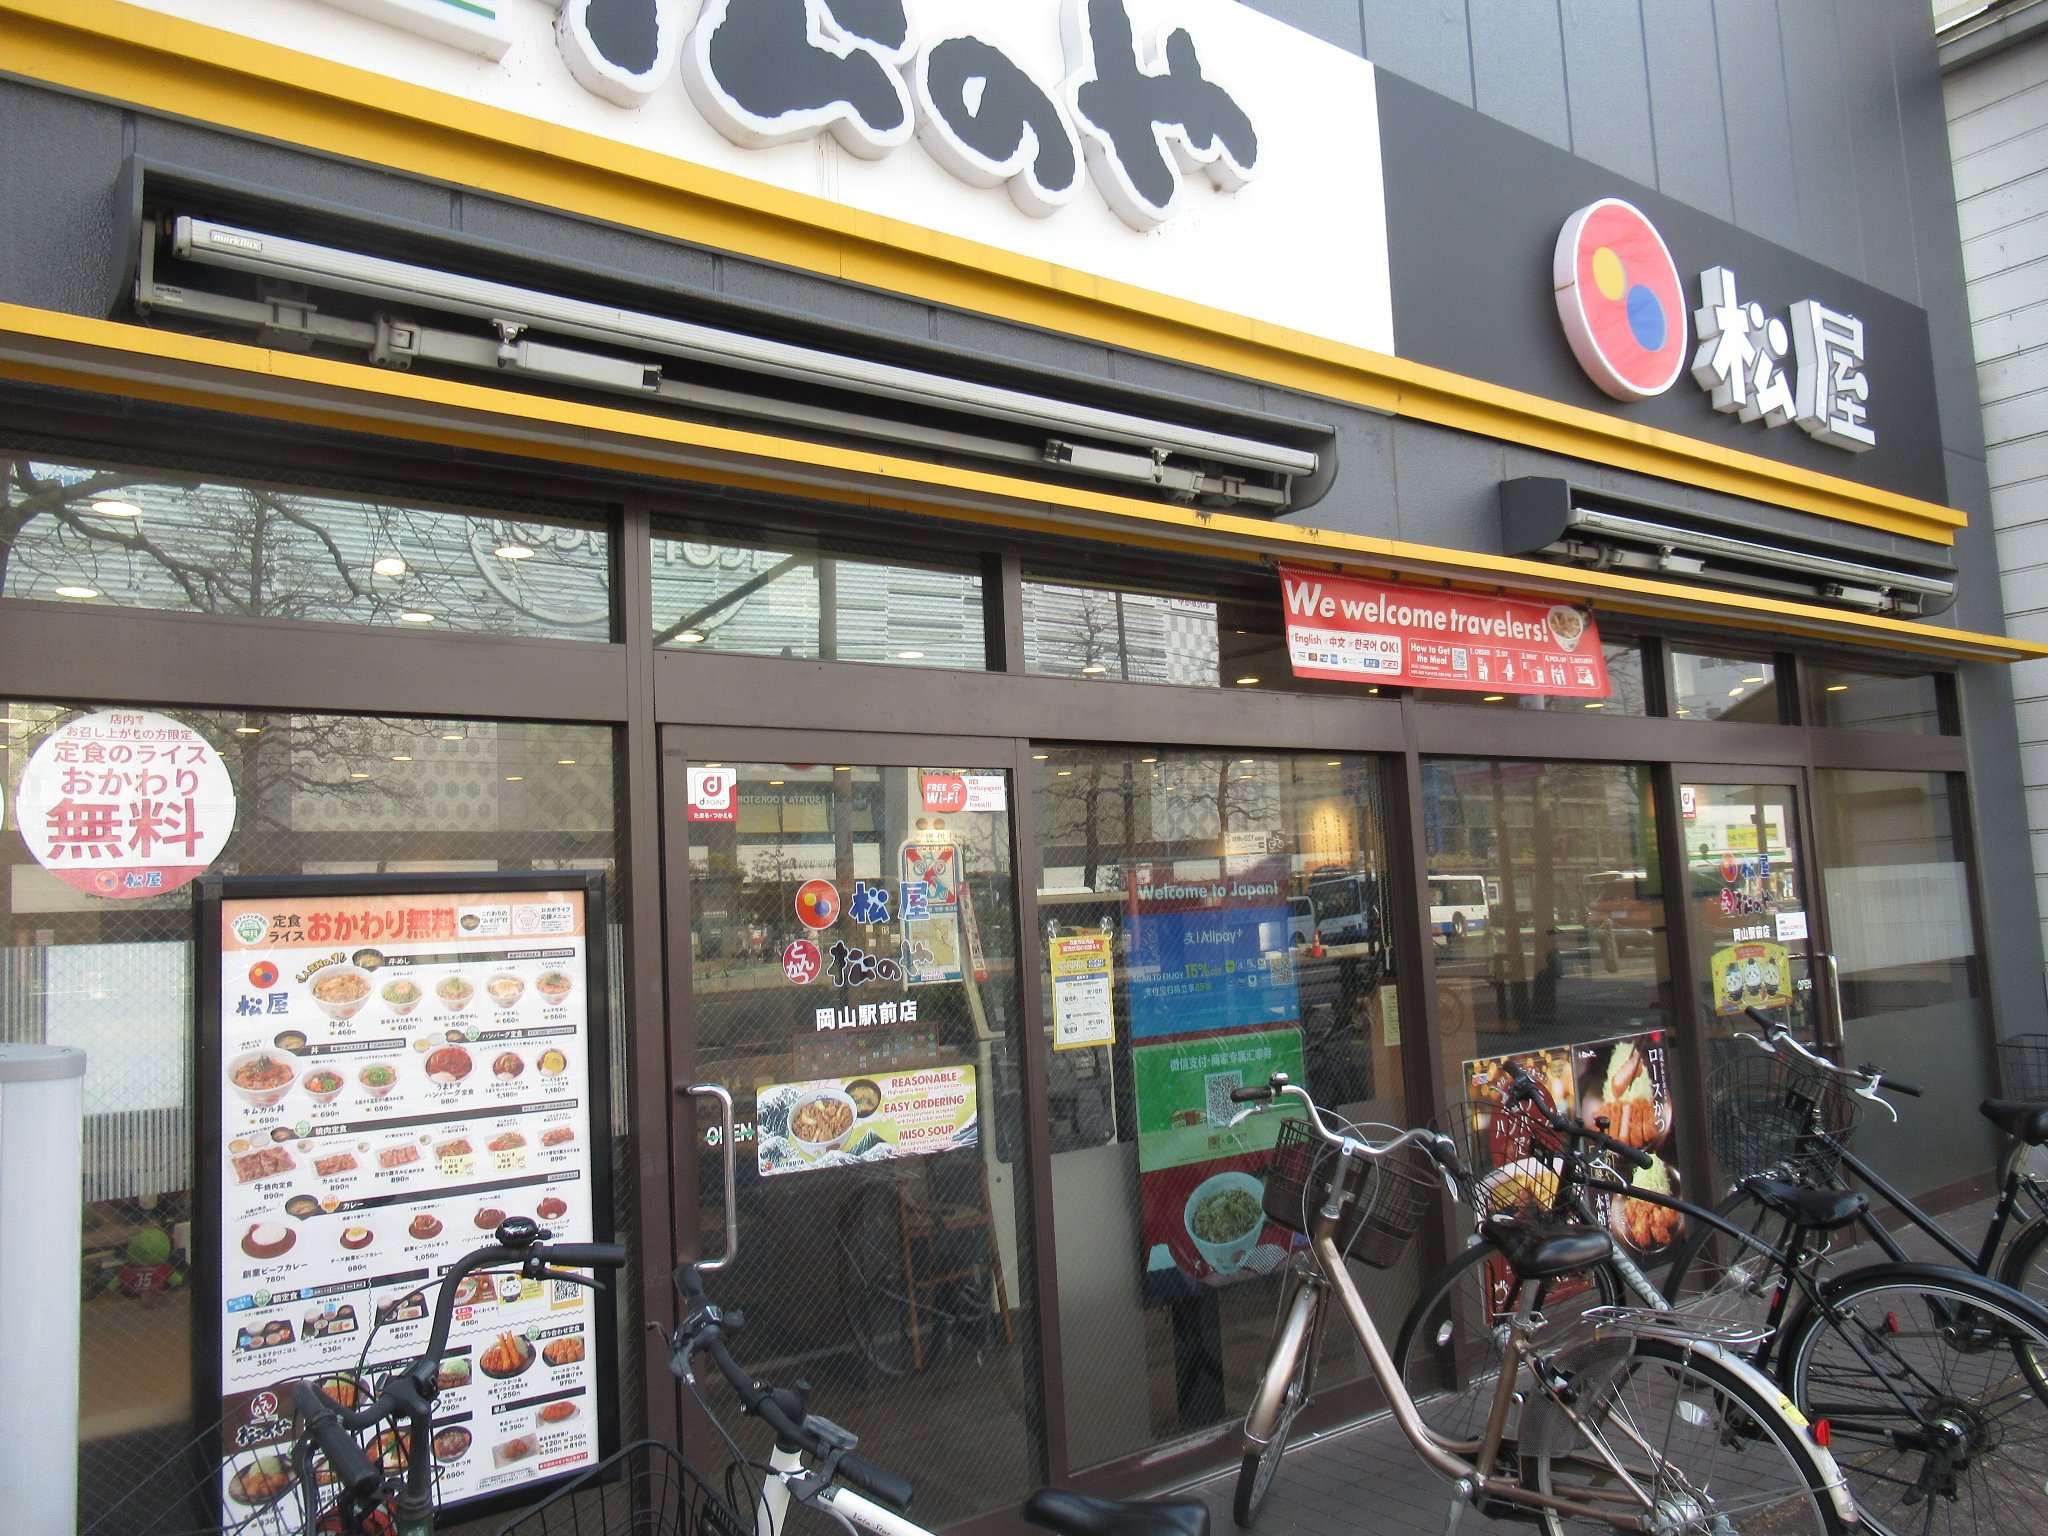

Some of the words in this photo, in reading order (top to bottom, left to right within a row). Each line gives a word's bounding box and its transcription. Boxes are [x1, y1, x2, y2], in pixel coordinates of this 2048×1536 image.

[1692, 265, 1875, 453] 松屋
[1284, 579, 1335, 618] We
[1340, 593, 1447, 631] welcome
[1450, 608, 1549, 643] travelers!
[1294, 633, 1322, 647] English
[1329, 636, 1346, 648] 中文
[1354, 638, 1377, 652] 한국어
[1379, 641, 1399, 653] OK!
[1410, 643, 1427, 653] How
[1429, 645, 1436, 653] to
[1437, 647, 1450, 656] Get
[1416, 655, 1429, 663] the
[1430, 656, 1449, 665] Meal
[110, 714, 145, 725] 店内で
[66, 726, 194, 741] お召し上がりの方限定
[53, 741, 208, 765] 定食のライス
[61, 767, 200, 797] おかわり
[926, 783, 948, 792] FREE
[926, 792, 961, 804] Wi-Fi
[46, 797, 205, 860] 無料
[123, 872, 163, 888] 松屋
[1136, 881, 1208, 900] Welcome
[1212, 882, 1227, 898] to
[1231, 880, 1279, 900] Japan!
[848, 880, 931, 923] 松屋
[272, 914, 302, 928] 定食
[306, 908, 457, 943] おかわり無料
[268, 931, 305, 943] ライス
[388, 957, 410, 965] 牛めし
[827, 939, 935, 988] 松のや
[235, 992, 289, 1016] 松屋
[815, 1000, 919, 1032] 岡山駅前店
[891, 1072, 957, 1089] REASONABLE
[1647, 1048, 1665, 1133] ロースかつ
[884, 1101, 910, 1113] EASY
[912, 1095, 965, 1110] ORDERING
[899, 1128, 925, 1141] MISO
[927, 1124, 954, 1137] SOUP
[343, 1202, 365, 1210] カレー
